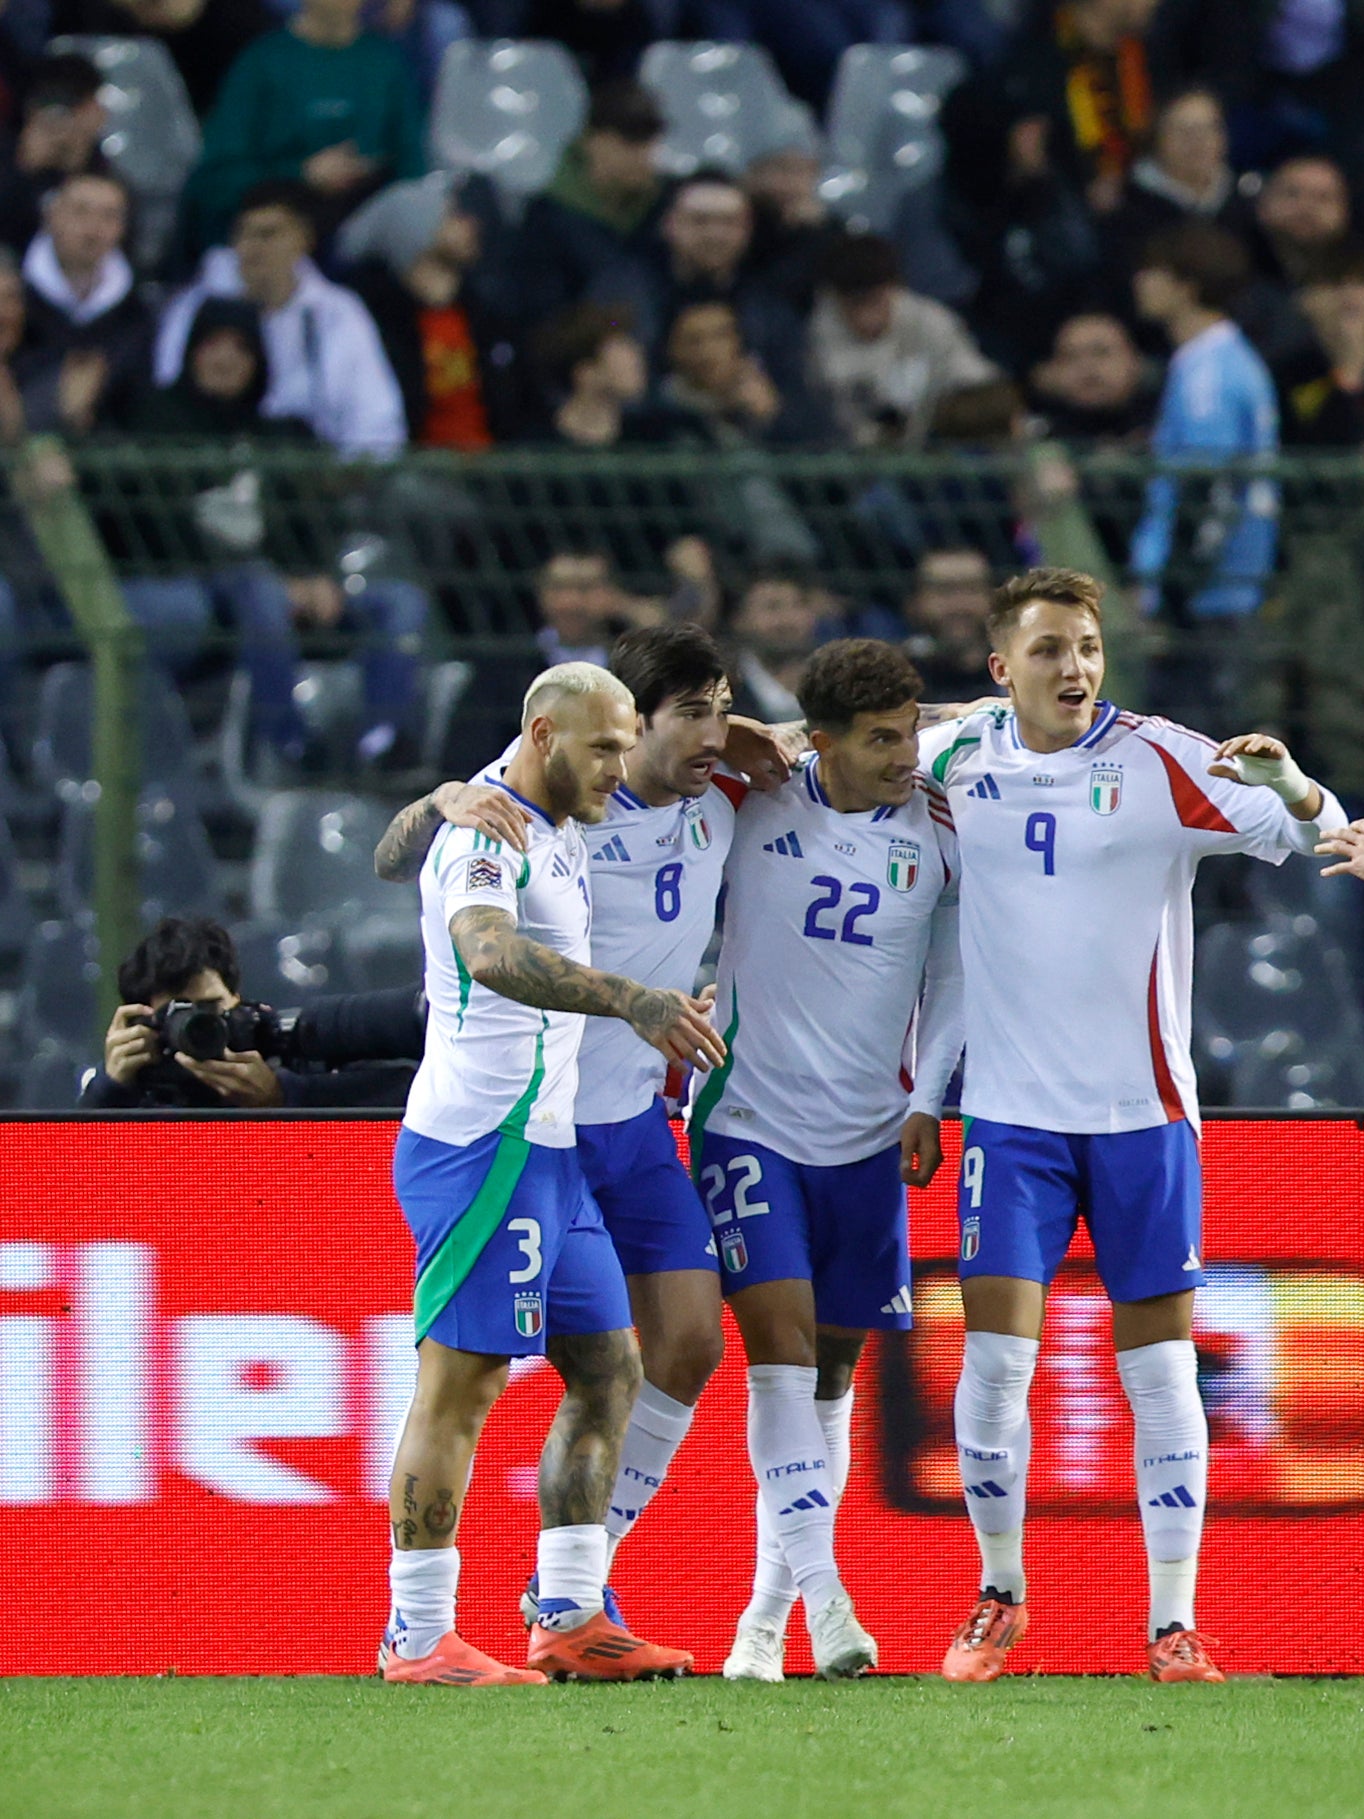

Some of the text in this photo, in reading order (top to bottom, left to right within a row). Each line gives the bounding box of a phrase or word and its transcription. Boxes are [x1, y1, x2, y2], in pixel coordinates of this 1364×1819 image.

[1093, 773, 1120, 782] ITALIA
[890, 849, 917, 860] ITALIA
[1025, 812, 1056, 875] 9
[655, 863, 684, 922] 8
[803, 875, 880, 946] 22
[701, 1154, 769, 1226] 22
[964, 1146, 985, 1208] 9
[507, 1218, 542, 1283] 3
[766, 1459, 826, 1480] ITALIA
[960, 1446, 1008, 1461] ALIA
[1143, 1450, 1200, 1468] ITALIA
